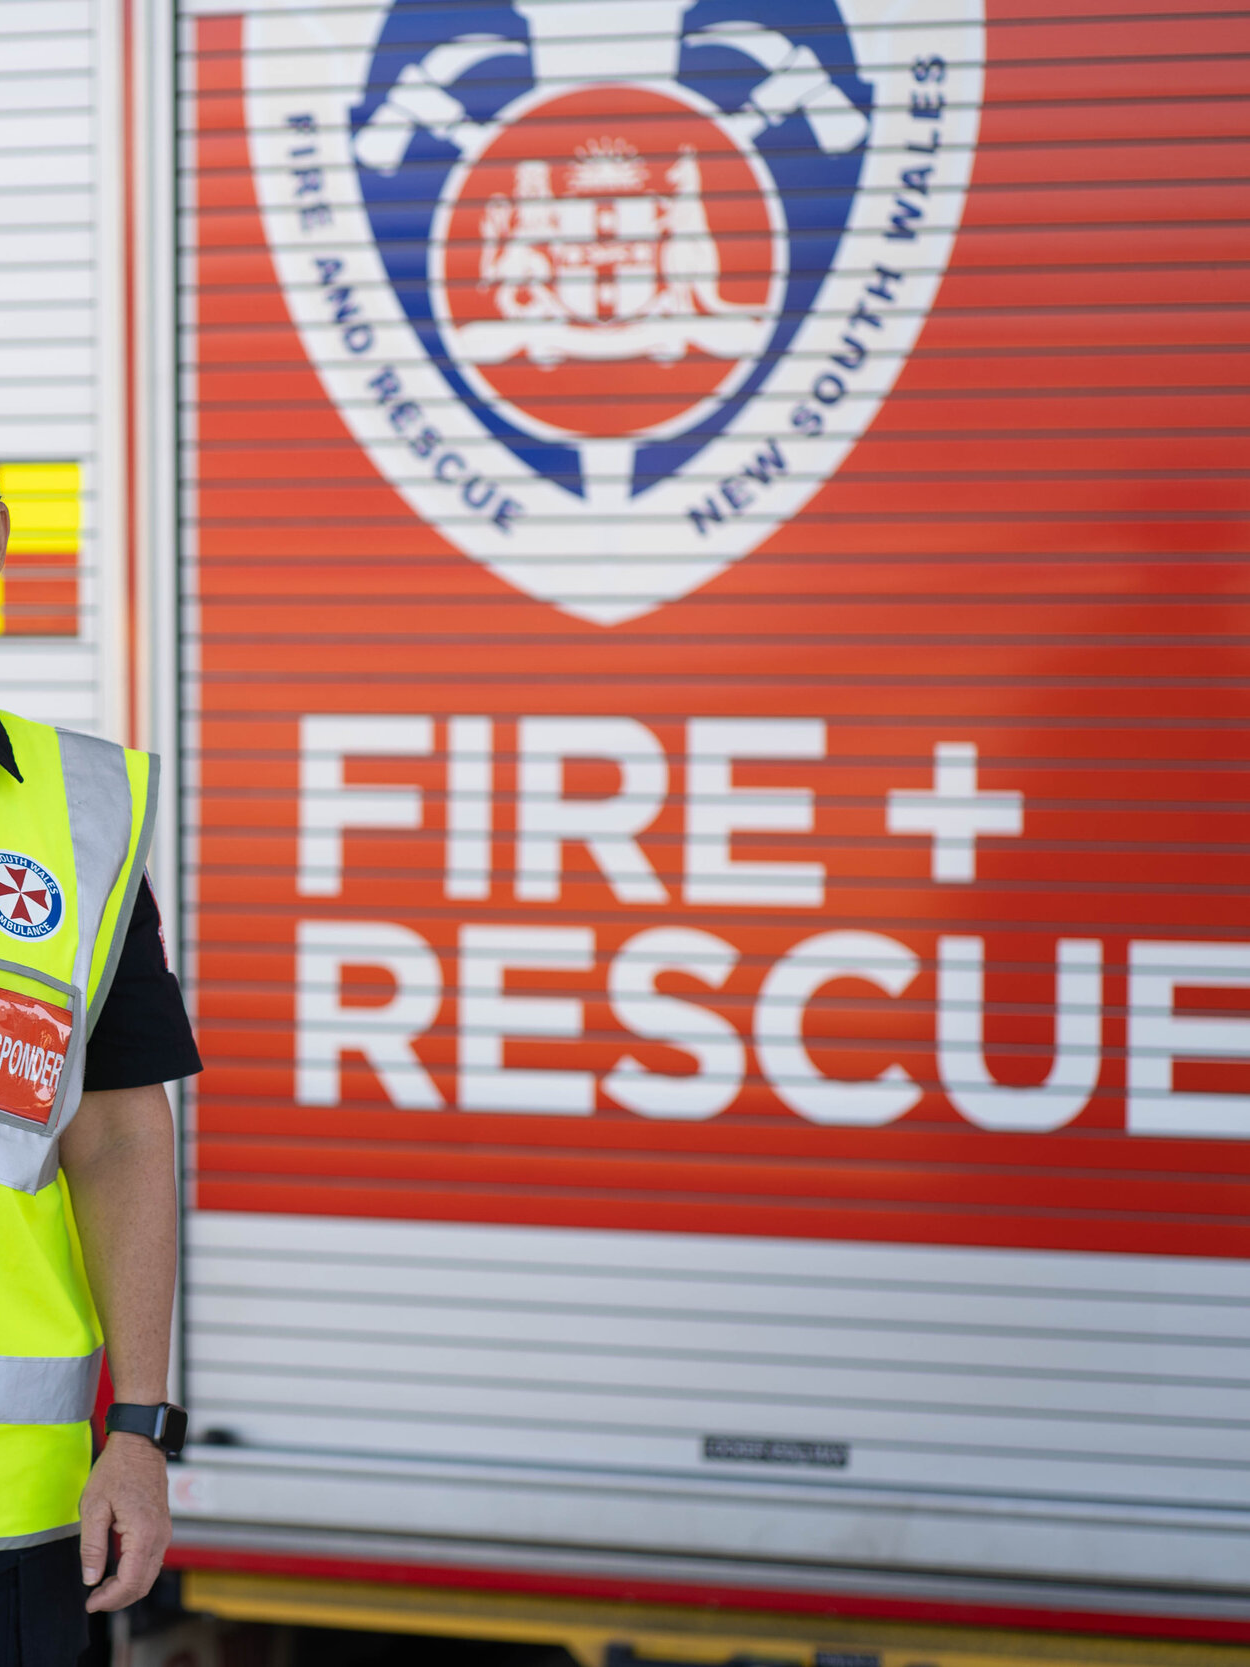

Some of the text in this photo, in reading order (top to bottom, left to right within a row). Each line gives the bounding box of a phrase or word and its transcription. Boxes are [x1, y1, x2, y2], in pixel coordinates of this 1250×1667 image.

[284, 110, 524, 534] FIRE AND RESCUE
[686, 54, 947, 537] NEW SOUTH WALES
[29, 863, 59, 895] WALES
[296, 714, 826, 907] FIRE
[294, 920, 1250, 1139] RESCUE
